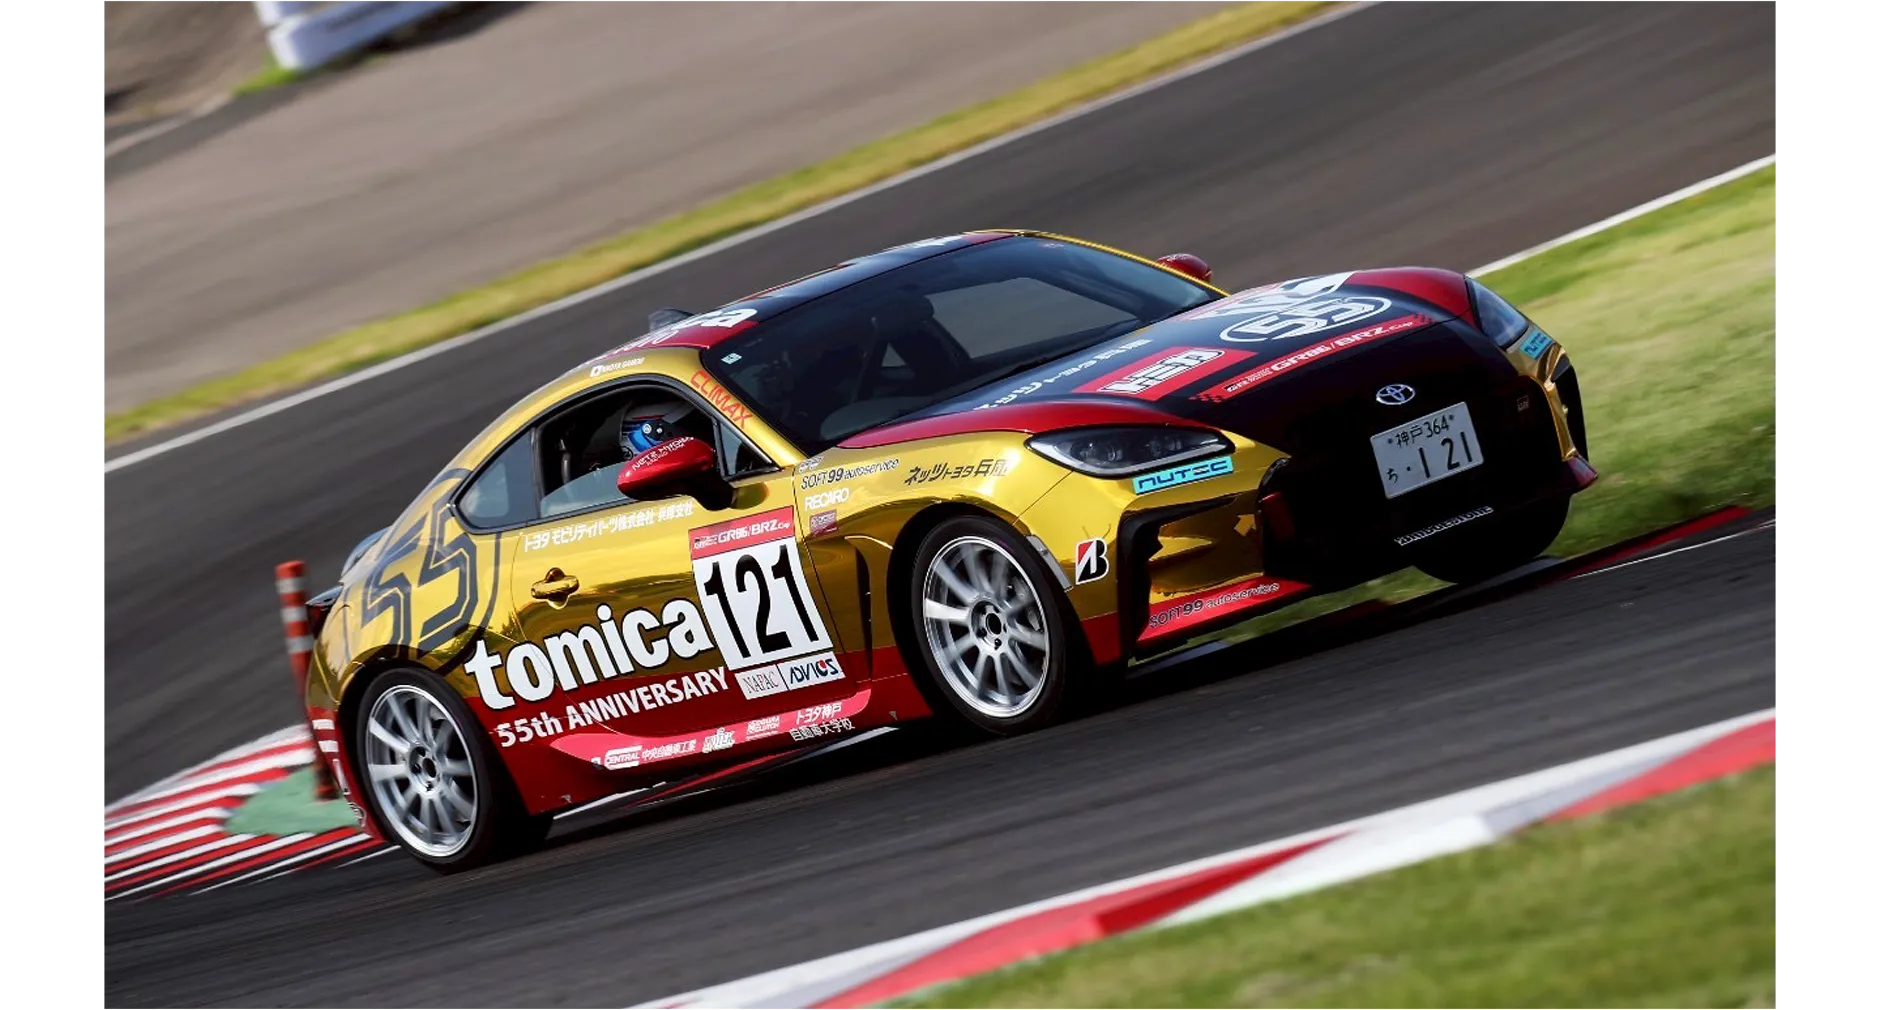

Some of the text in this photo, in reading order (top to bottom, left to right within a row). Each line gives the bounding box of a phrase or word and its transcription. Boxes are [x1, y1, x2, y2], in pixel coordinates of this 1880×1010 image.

[690, 369, 753, 429] CLIMAX
[804, 487, 851, 511] RECARO
[717, 519, 779, 545] GR86/BRZ
[704, 544, 819, 659] 121
[1205, 582, 1280, 608] autoservice
[464, 597, 714, 710] tomica
[742, 658, 840, 694] NAPAC ADVICS
[496, 666, 729, 748] 55th ANNIVERSARY
[795, 701, 843, 726] トヨタ神戸
[604, 750, 641, 767] CENTRAL
